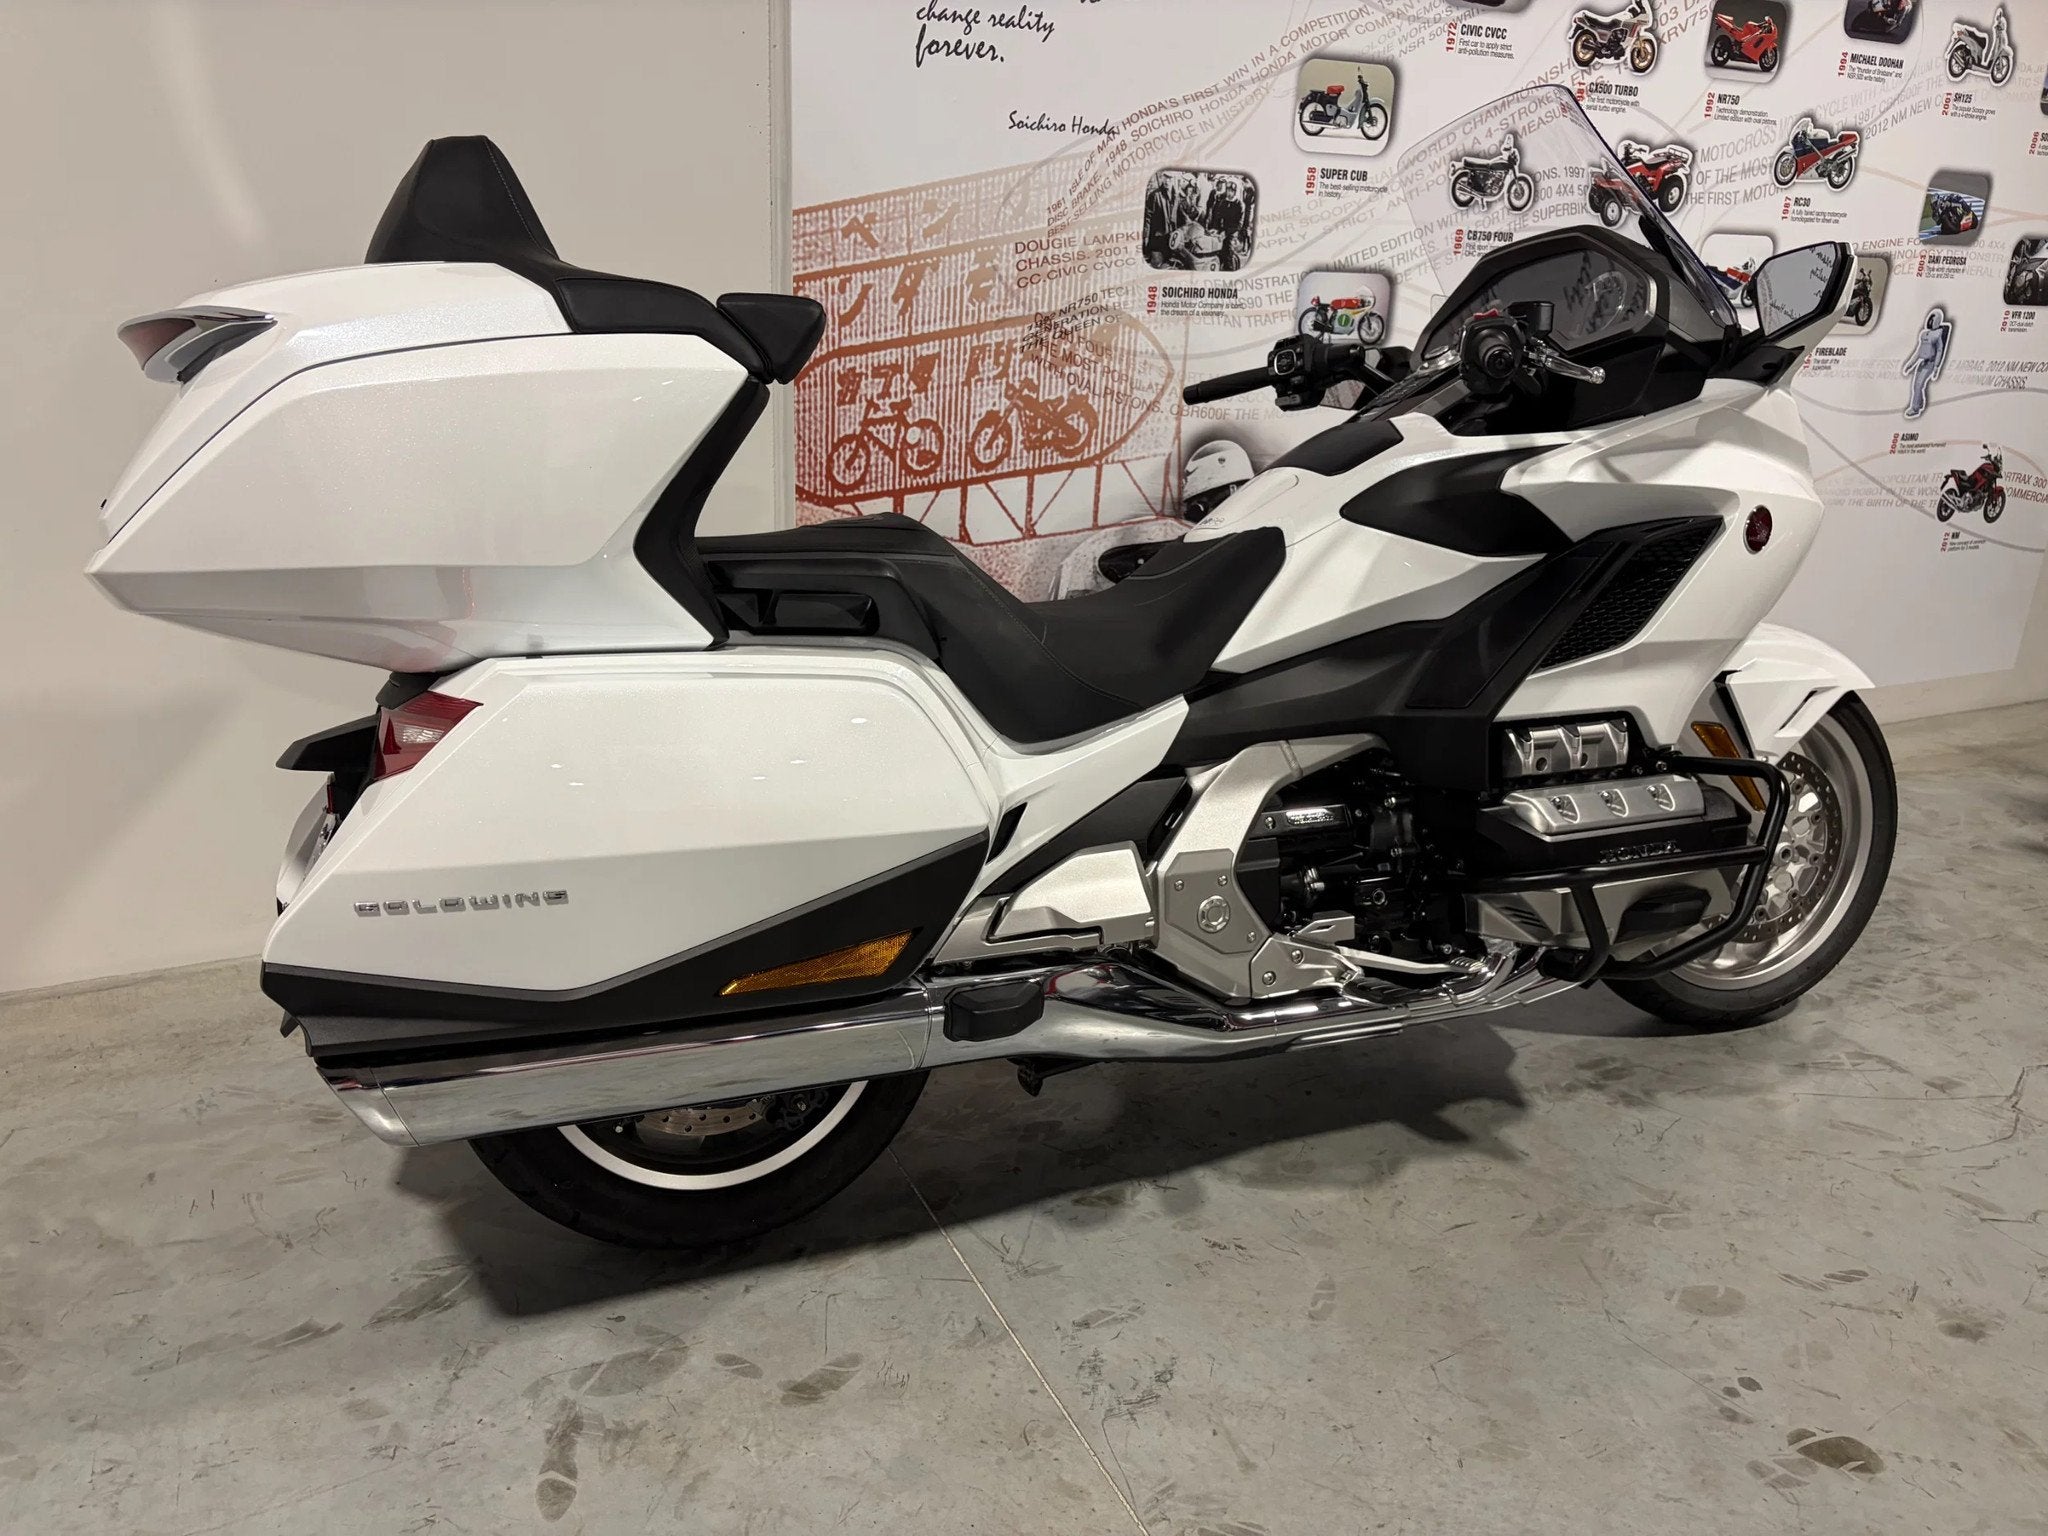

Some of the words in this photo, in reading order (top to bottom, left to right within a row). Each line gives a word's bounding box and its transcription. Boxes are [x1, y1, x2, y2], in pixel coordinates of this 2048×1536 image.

[916, 0, 981, 35] change
[988, 5, 1055, 42] reality
[1460, 24, 1484, 37] CIVIC
[1484, 25, 1508, 40] CVCC
[915, 23, 1005, 68] forever.
[1446, 22, 1458, 52] 1972
[1459, 38, 1472, 46] First
[1480, 40, 1485, 48] to
[1486, 42, 1499, 50] apply
[1458, 47, 1490, 57] anti-pollution
[1838, 51, 1848, 76] 1994
[1850, 53, 1877, 66] MICHAEL
[1878, 57, 1905, 69] DOOHAN
[1067, 169, 1086, 196] ISLE
[1084, 153, 1096, 170] OF
[1121, 98, 1180, 132] HONDA'S
[1182, 83, 1221, 106] FIRST
[1222, 63, 1250, 87] WIN
[1252, 51, 1266, 68] IN
[1268, 43, 1283, 57] A
[1280, 4, 1376, 49] COMPETITION.
[1614, 84, 1639, 97] TURBO
[1717, 94, 1740, 105] NR750
[1953, 92, 1973, 103] SH125
[1704, 92, 1715, 118] 1992
[1942, 92, 1952, 116] 2001
[1008, 110, 1067, 130] Soichiro
[1071, 115, 1116, 136] Honda
[1047, 207, 1069, 227] DISC
[1104, 139, 1129, 168] 1948
[1131, 109, 1195, 142] SOICHIRO
[1198, 84, 1248, 113] HONDA
[1250, 51, 1297, 83] HONDA
[1300, 27, 1351, 53] MOTOR
[1864, 118, 1889, 141] 2012
[1112, 120, 1198, 181] MOTORCYCLE
[1199, 115, 1215, 134] IN
[1305, 166, 1317, 196] 1958
[1320, 167, 1349, 180] SUPER
[1350, 170, 1368, 181] CUB
[1563, 166, 1586, 179] 1997
[1714, 164, 1739, 185] THE
[1707, 190, 1740, 206] FIRST
[1014, 236, 1077, 255] DOUGIE
[1083, 231, 1144, 247] LAMPKI
[1380, 220, 1435, 252] EDITION
[1453, 228, 1464, 255] 1969
[1467, 230, 1491, 242] CB750
[1493, 231, 1513, 242] FOUR
[1862, 237, 1904, 250] ENGINE
[1015, 250, 1090, 272] CHASSIS.
[1095, 246, 1129, 259] 2001
[1093, 257, 1136, 271] CVCC
[1928, 255, 1942, 264] DANI
[1146, 286, 1158, 315] 1948
[1162, 286, 1205, 299] SOICHIRO
[1207, 287, 1238, 300] HONDA
[1058, 293, 1098, 317] NR750
[1161, 301, 1179, 309] Honda
[1181, 301, 1198, 309] Motor
[1061, 347, 1099, 372] MOST
[1814, 347, 1847, 356] FIREBLADE
[1066, 372, 1100, 398] OVAL
[1889, 432, 1900, 455] 2000
[1900, 433, 1919, 441] ASIMO
[354, 889, 569, 917] GOLDWING
